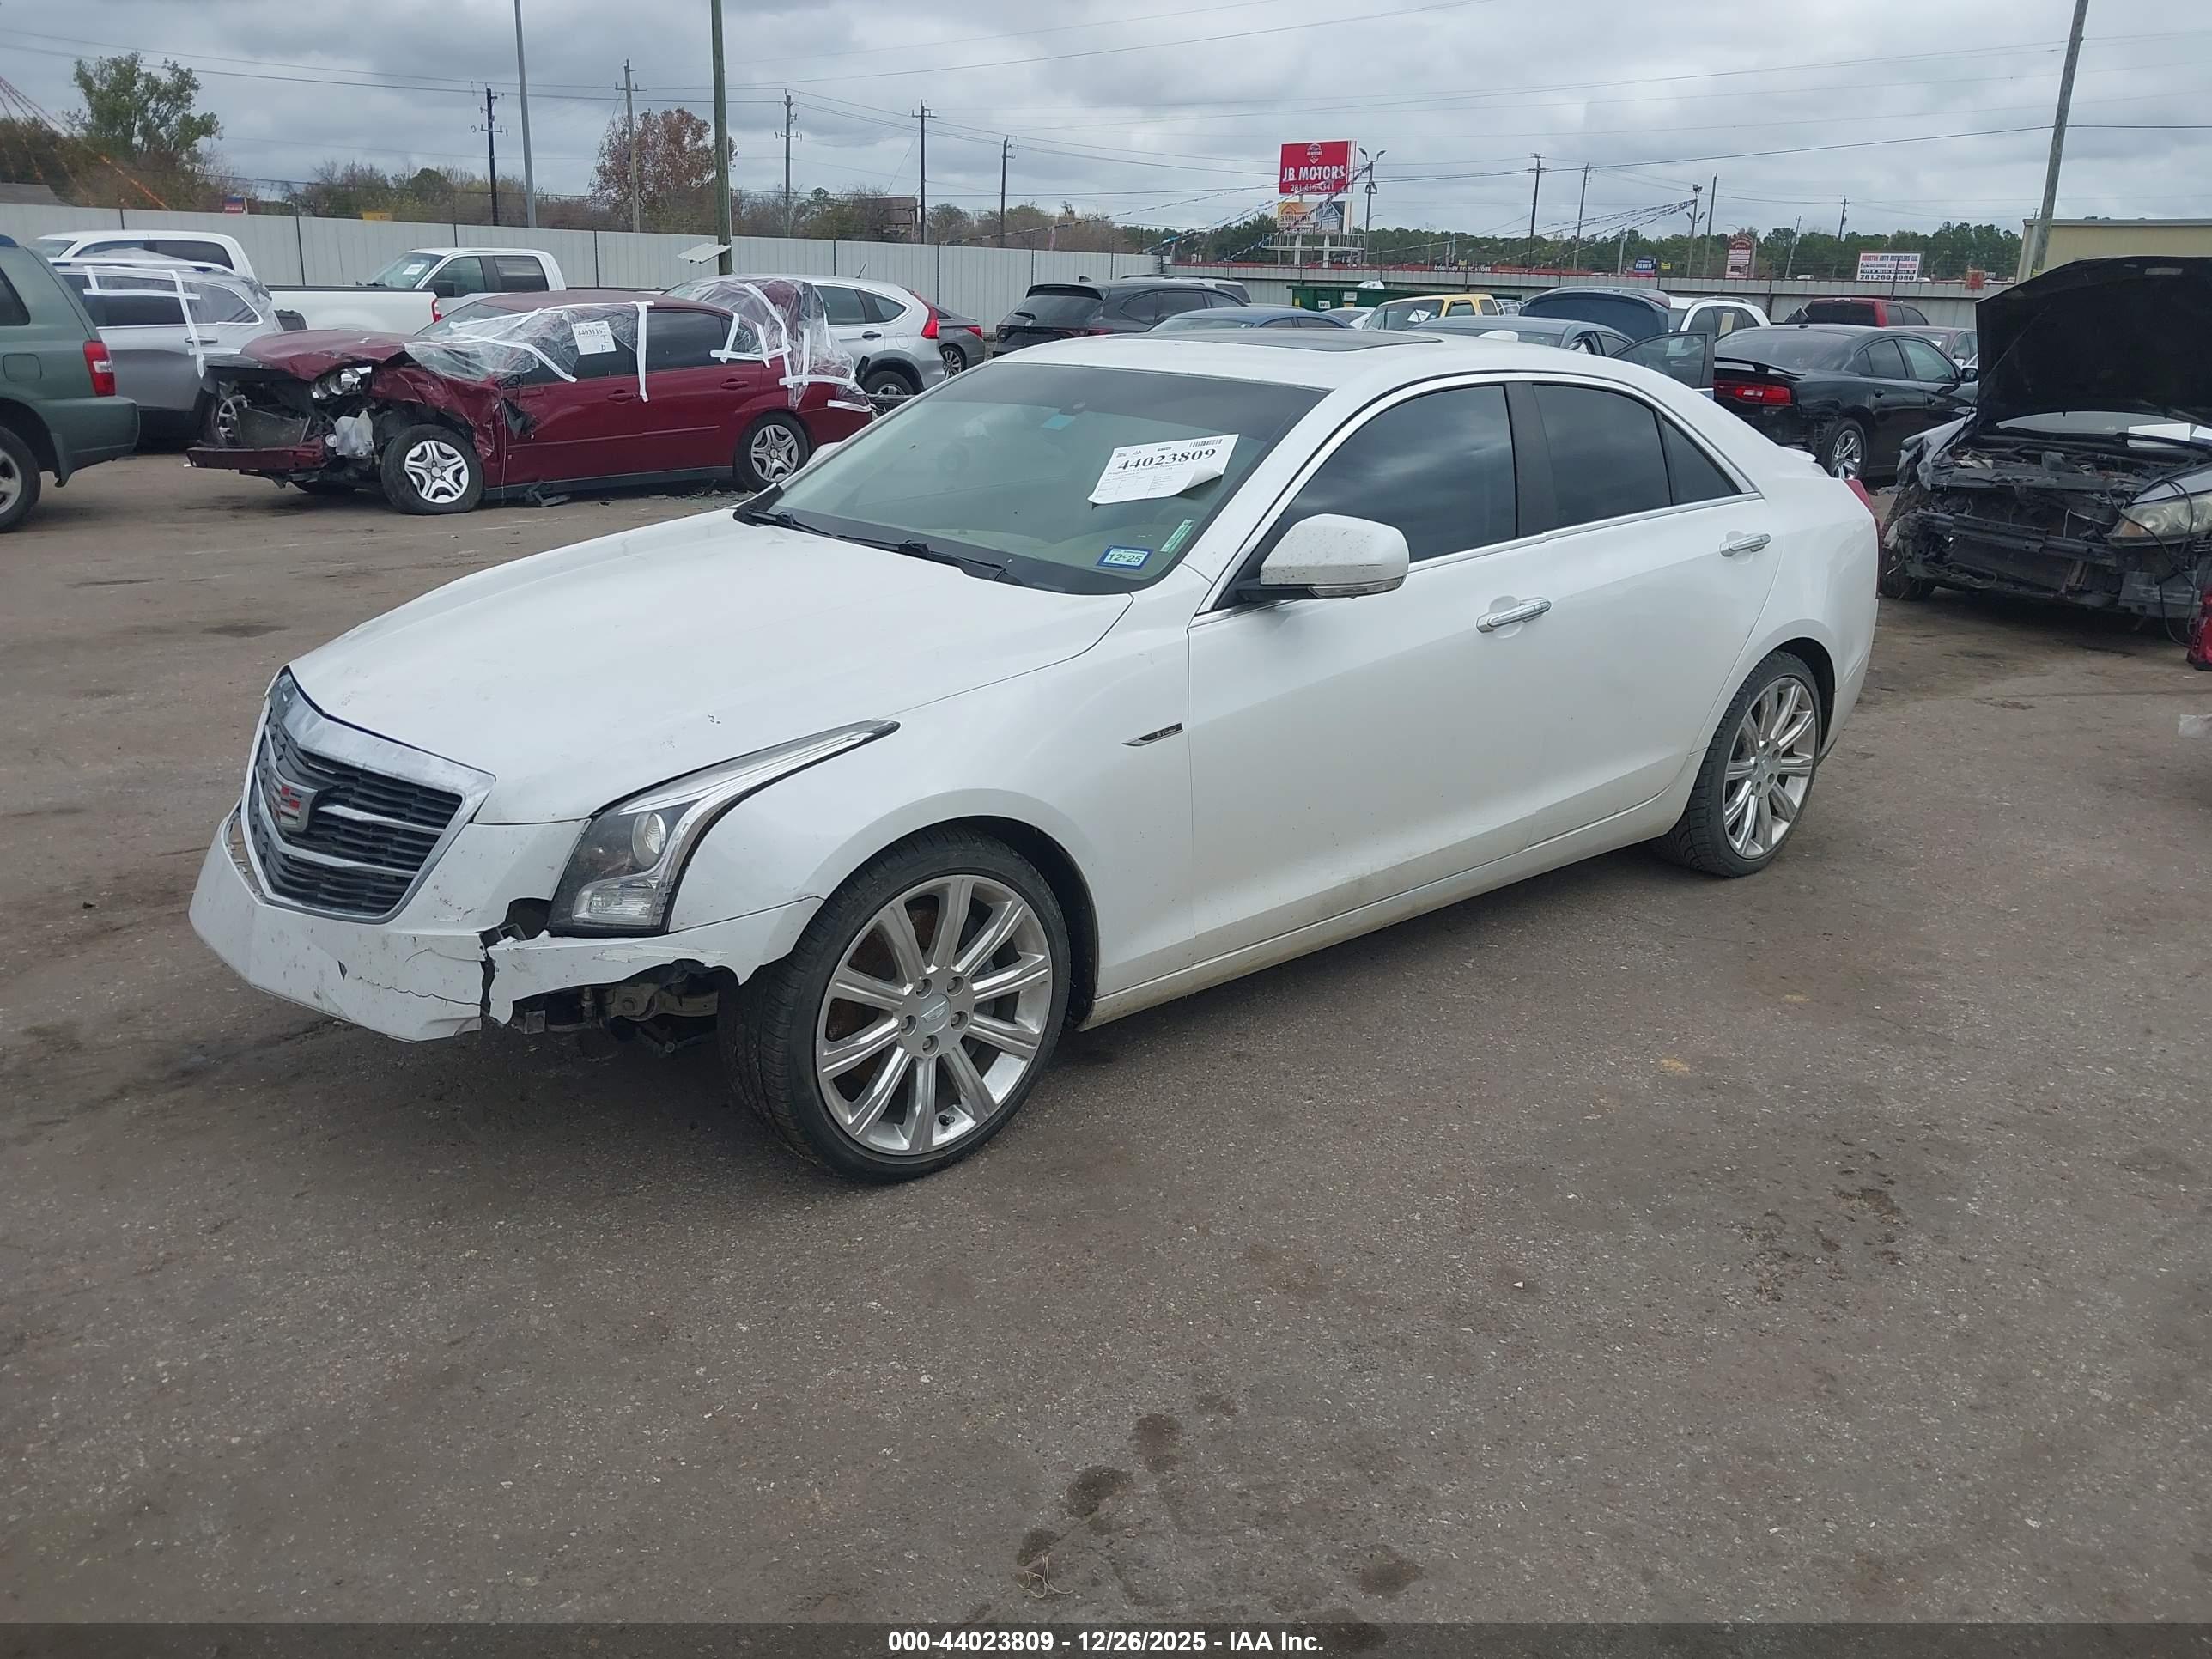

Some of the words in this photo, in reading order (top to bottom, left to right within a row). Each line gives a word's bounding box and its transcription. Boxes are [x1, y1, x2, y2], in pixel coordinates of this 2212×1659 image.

[1283, 167, 1296, 181] JB
[1298, 165, 1345, 181] MOTORS
[1117, 448, 1217, 470] 44023809
